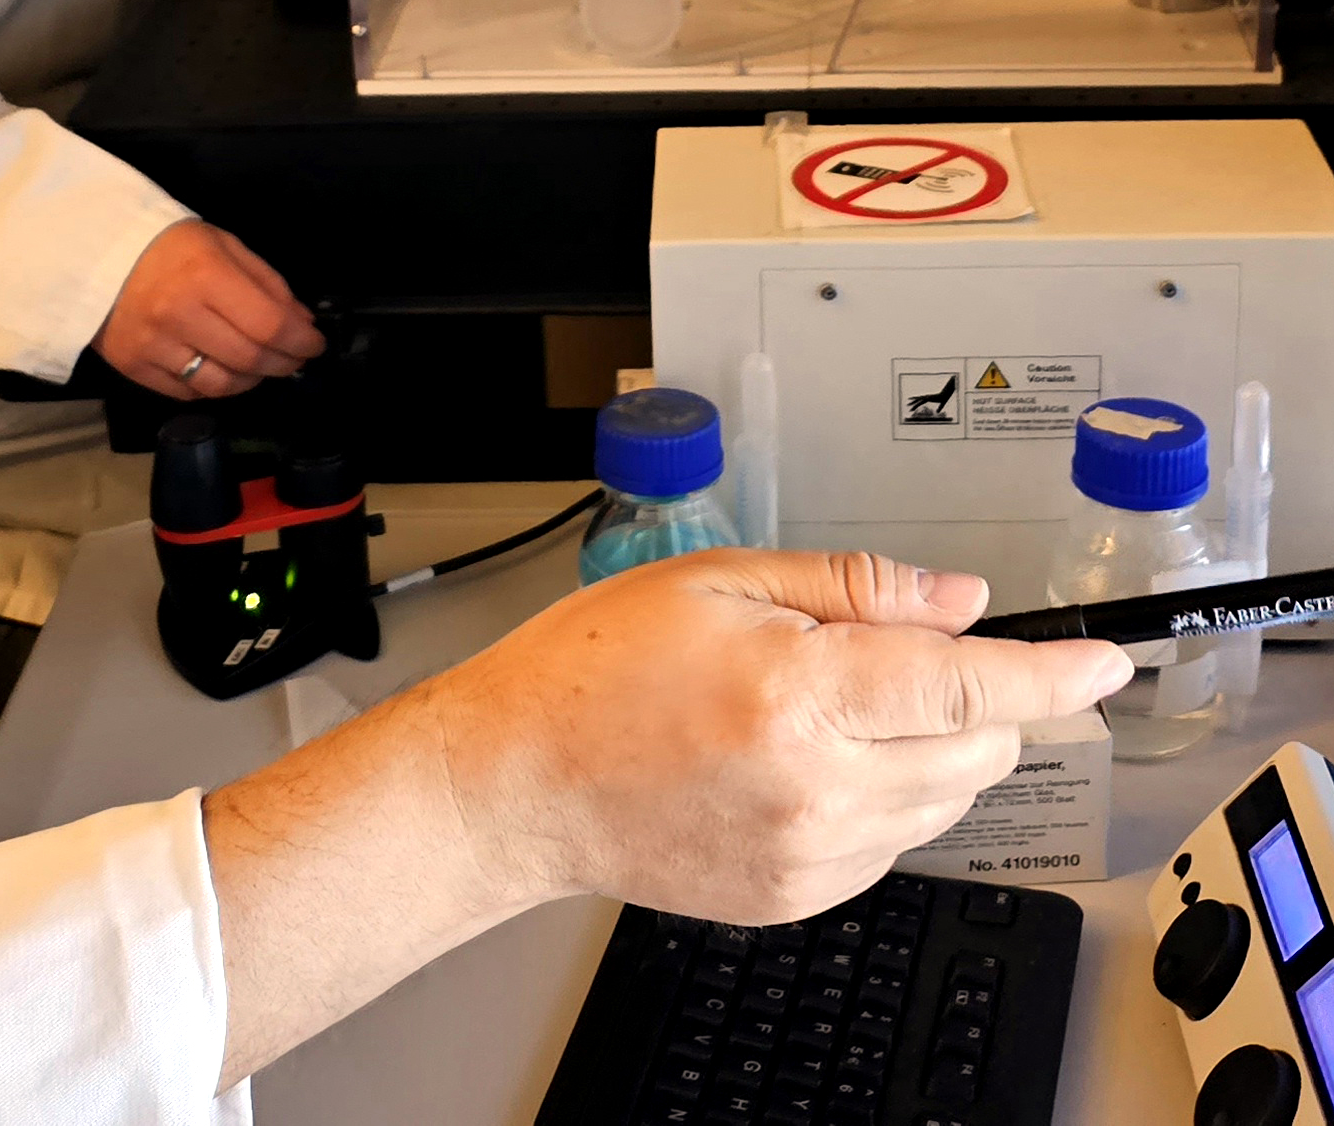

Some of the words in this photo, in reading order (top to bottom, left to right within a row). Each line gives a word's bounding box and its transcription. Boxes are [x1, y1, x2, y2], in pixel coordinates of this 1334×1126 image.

[1027, 363, 1072, 373] Caution
[1011, 759, 1066, 775] papier,
[968, 859, 998, 872] No.
[1001, 854, 1081, 870] 41019010
[842, 922, 861, 933] Q
[779, 954, 796, 965] S
[833, 954, 852, 965] W
[719, 963, 736, 974] X
[869, 976, 882, 985] 3
[767, 988, 784, 999] D
[823, 988, 842, 998] E
[706, 998, 725, 1011] C
[757, 1023, 773, 1034] F
[814, 1023, 833, 1034] R
[694, 1035, 713, 1045] V
[850, 1045, 864, 1054] 5
[743, 1060, 762, 1073] G
[804, 1061, 821, 1071] T
[681, 1069, 700, 1081] B
[839, 1084, 854, 1093] 6
[730, 1098, 749, 1110] H
[791, 1099, 811, 1110] Y
[668, 1108, 688, 1121] N
